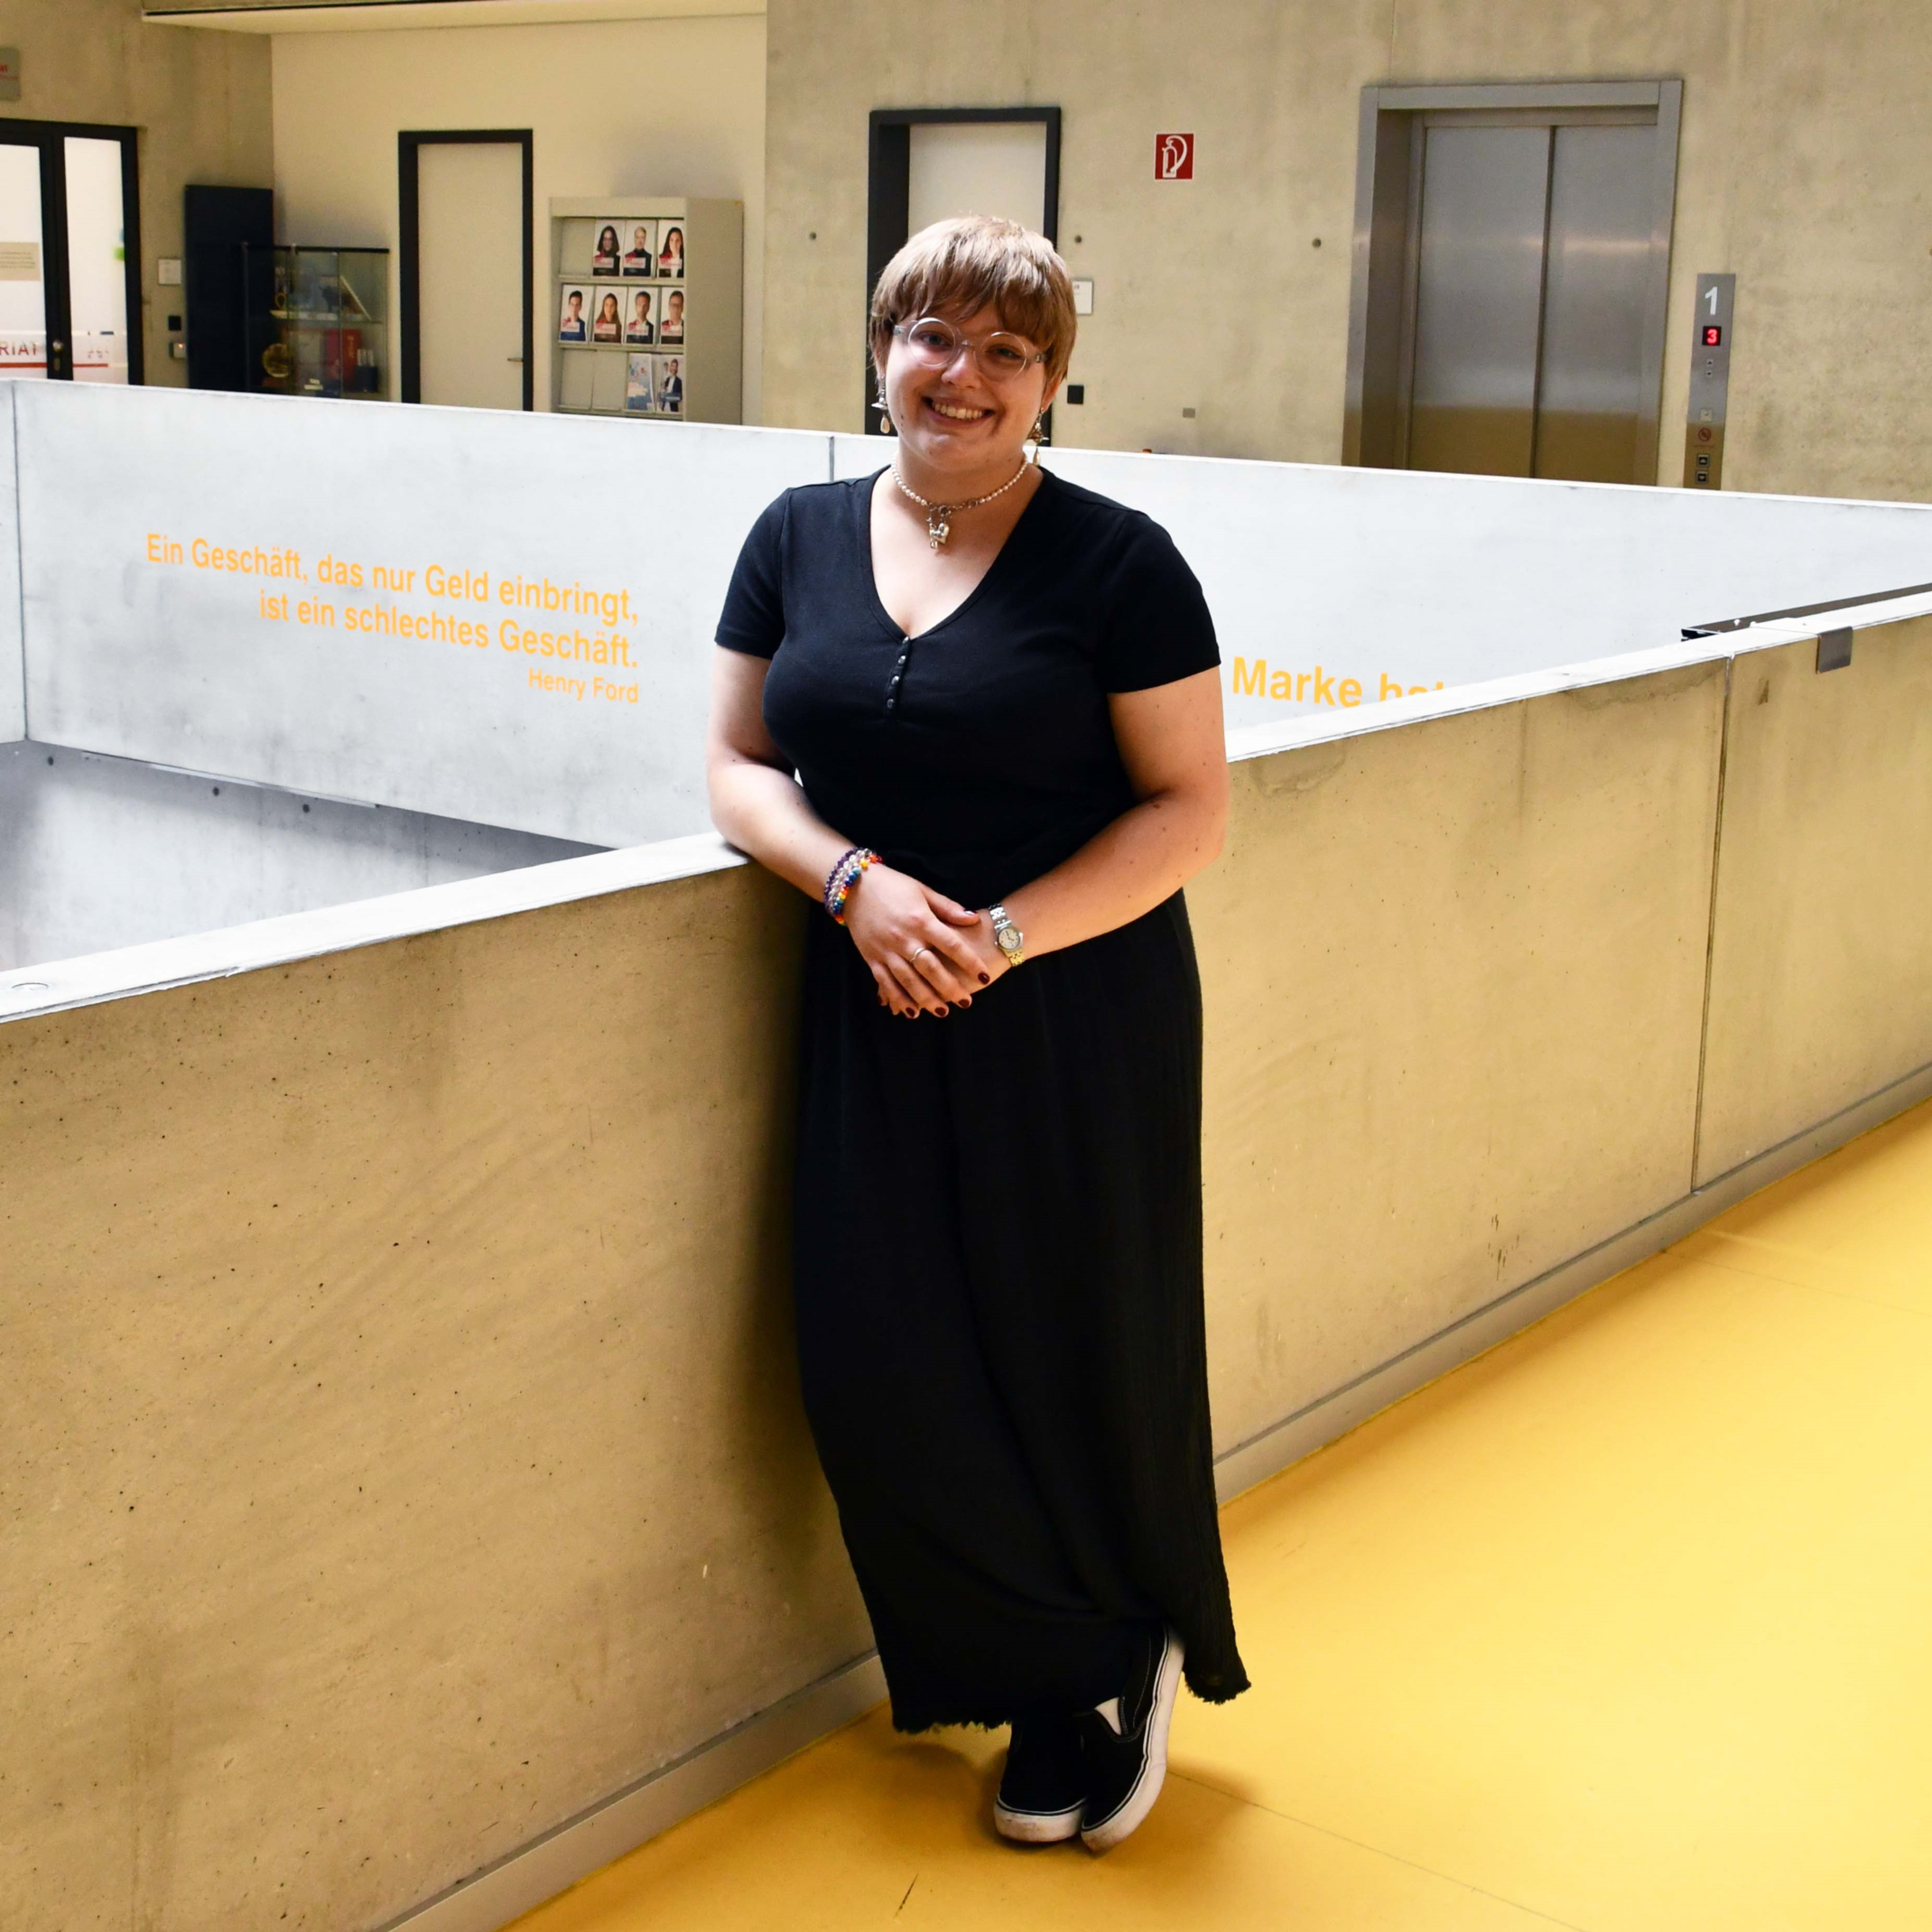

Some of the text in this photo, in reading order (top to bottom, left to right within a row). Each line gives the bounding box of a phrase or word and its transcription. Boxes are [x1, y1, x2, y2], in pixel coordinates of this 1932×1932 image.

[1704, 286, 1718, 315] 1
[1706, 328, 1718, 345] 3
[146, 534, 638, 627] Ein Geschäft, das nur Geld einbringt,
[259, 589, 638, 668] ist ein schlechtes Geschäft.
[528, 667, 638, 703] Henry Ford
[1232, 656, 1363, 708] Marke
